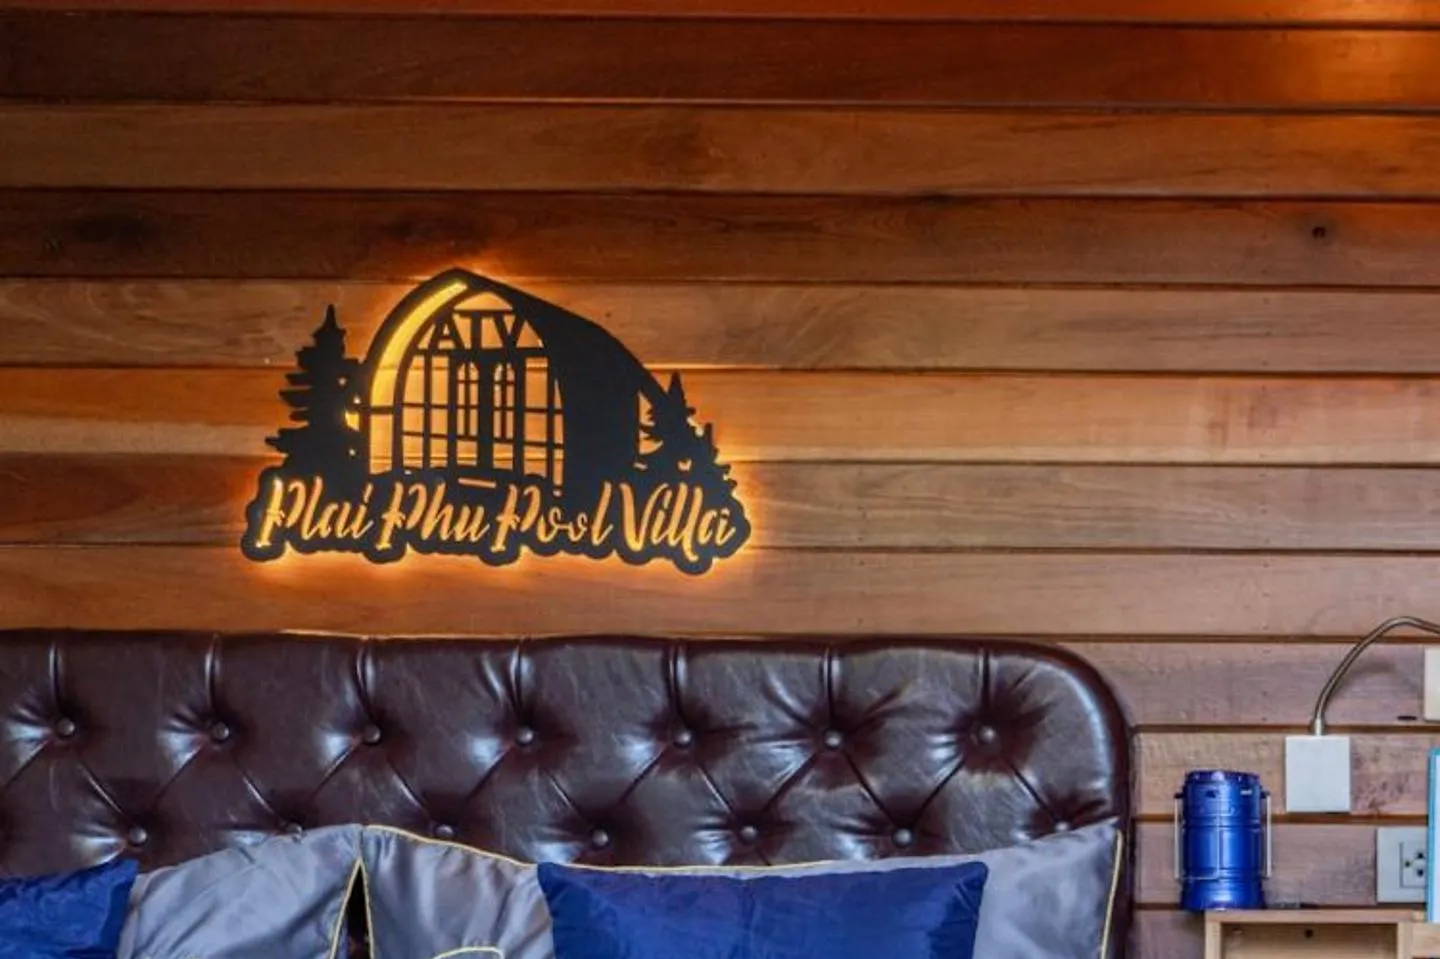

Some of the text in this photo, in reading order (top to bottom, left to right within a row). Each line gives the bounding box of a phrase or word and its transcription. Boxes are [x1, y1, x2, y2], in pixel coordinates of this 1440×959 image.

[254, 475, 737, 562] Plai Phu Pool Villa
